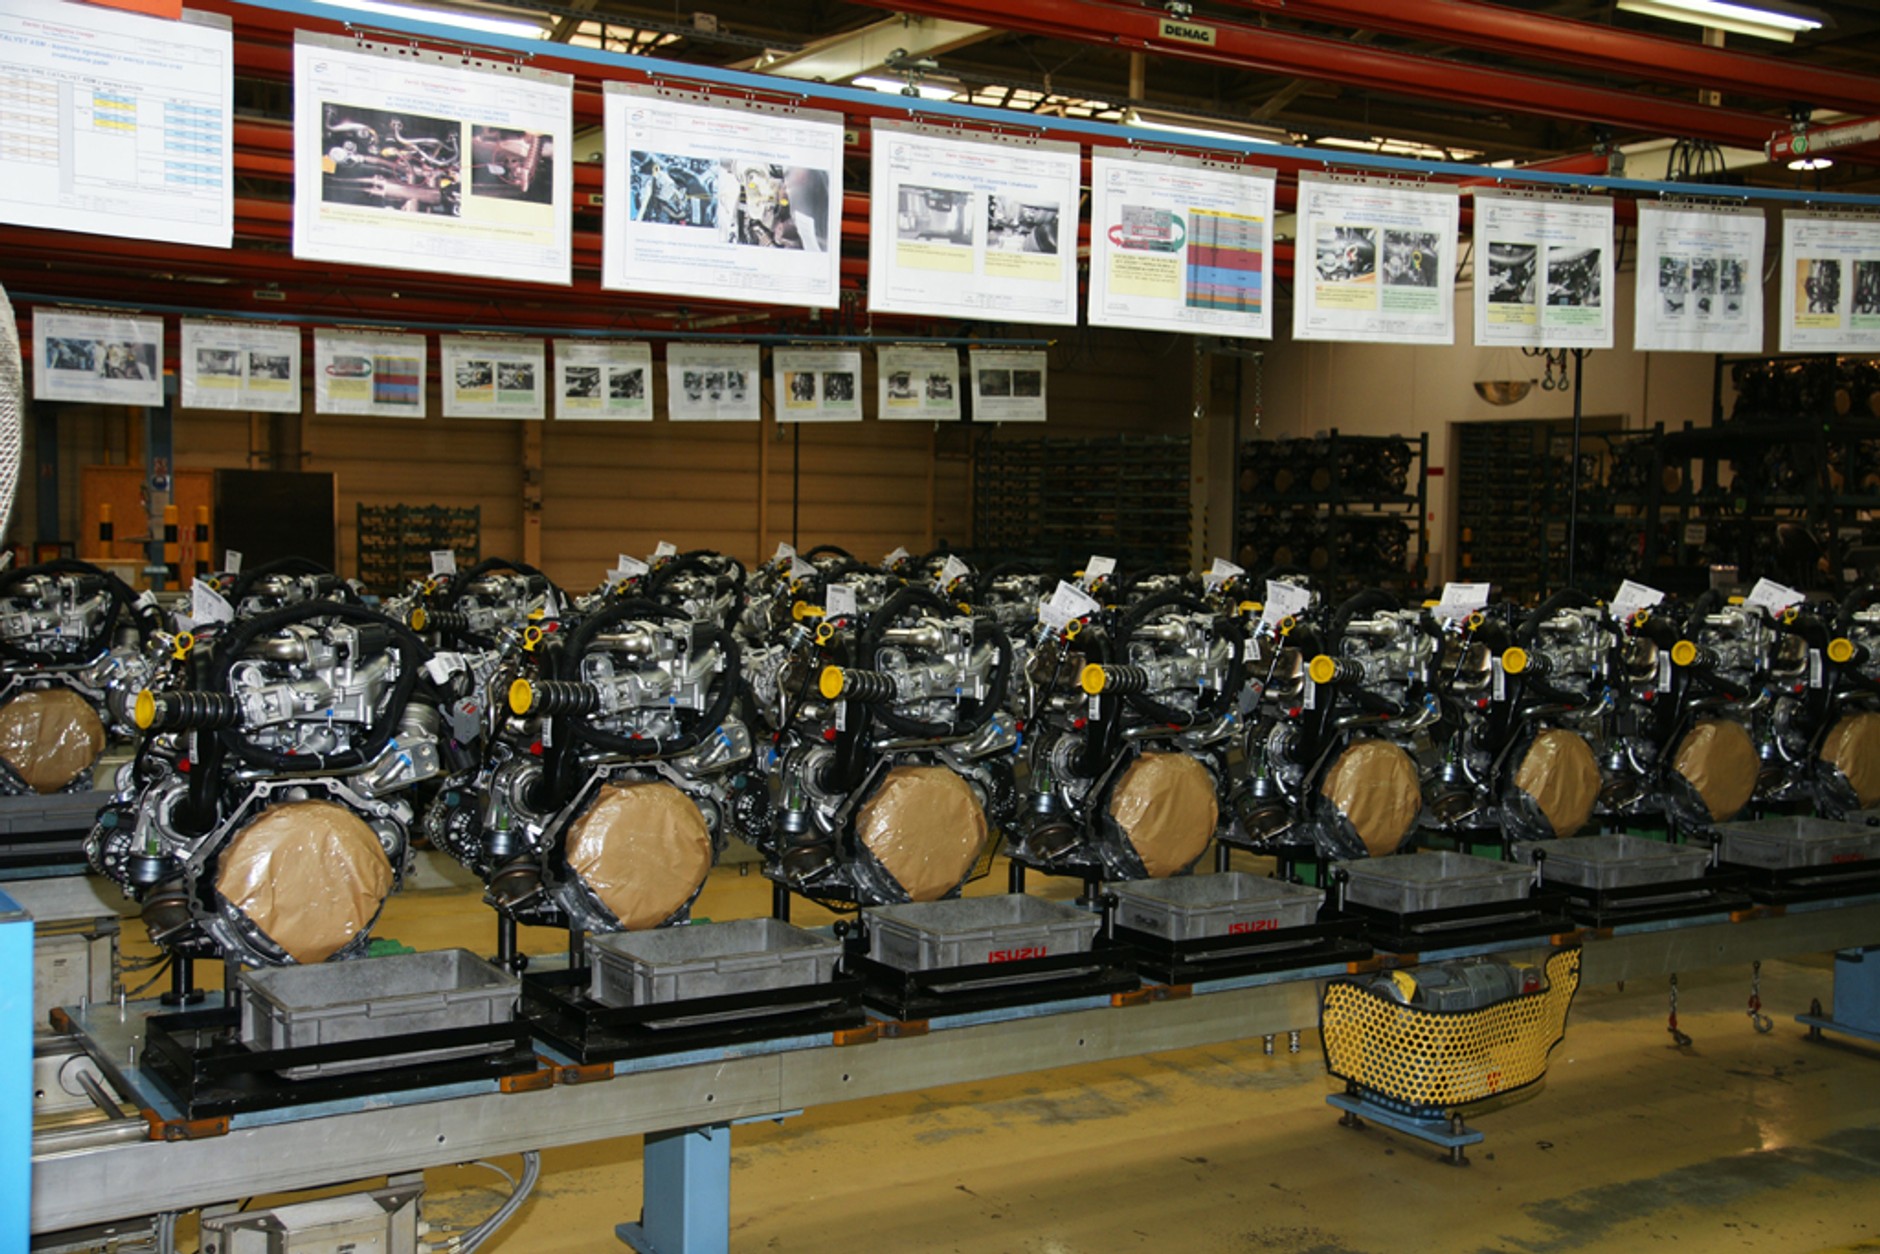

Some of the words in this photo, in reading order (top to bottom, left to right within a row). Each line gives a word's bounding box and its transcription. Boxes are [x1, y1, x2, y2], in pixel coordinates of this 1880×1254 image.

[1164, 24, 1209, 42] DEMAG
[1229, 918, 1278, 936] ISUZU
[988, 946, 1047, 964] ISUZU
